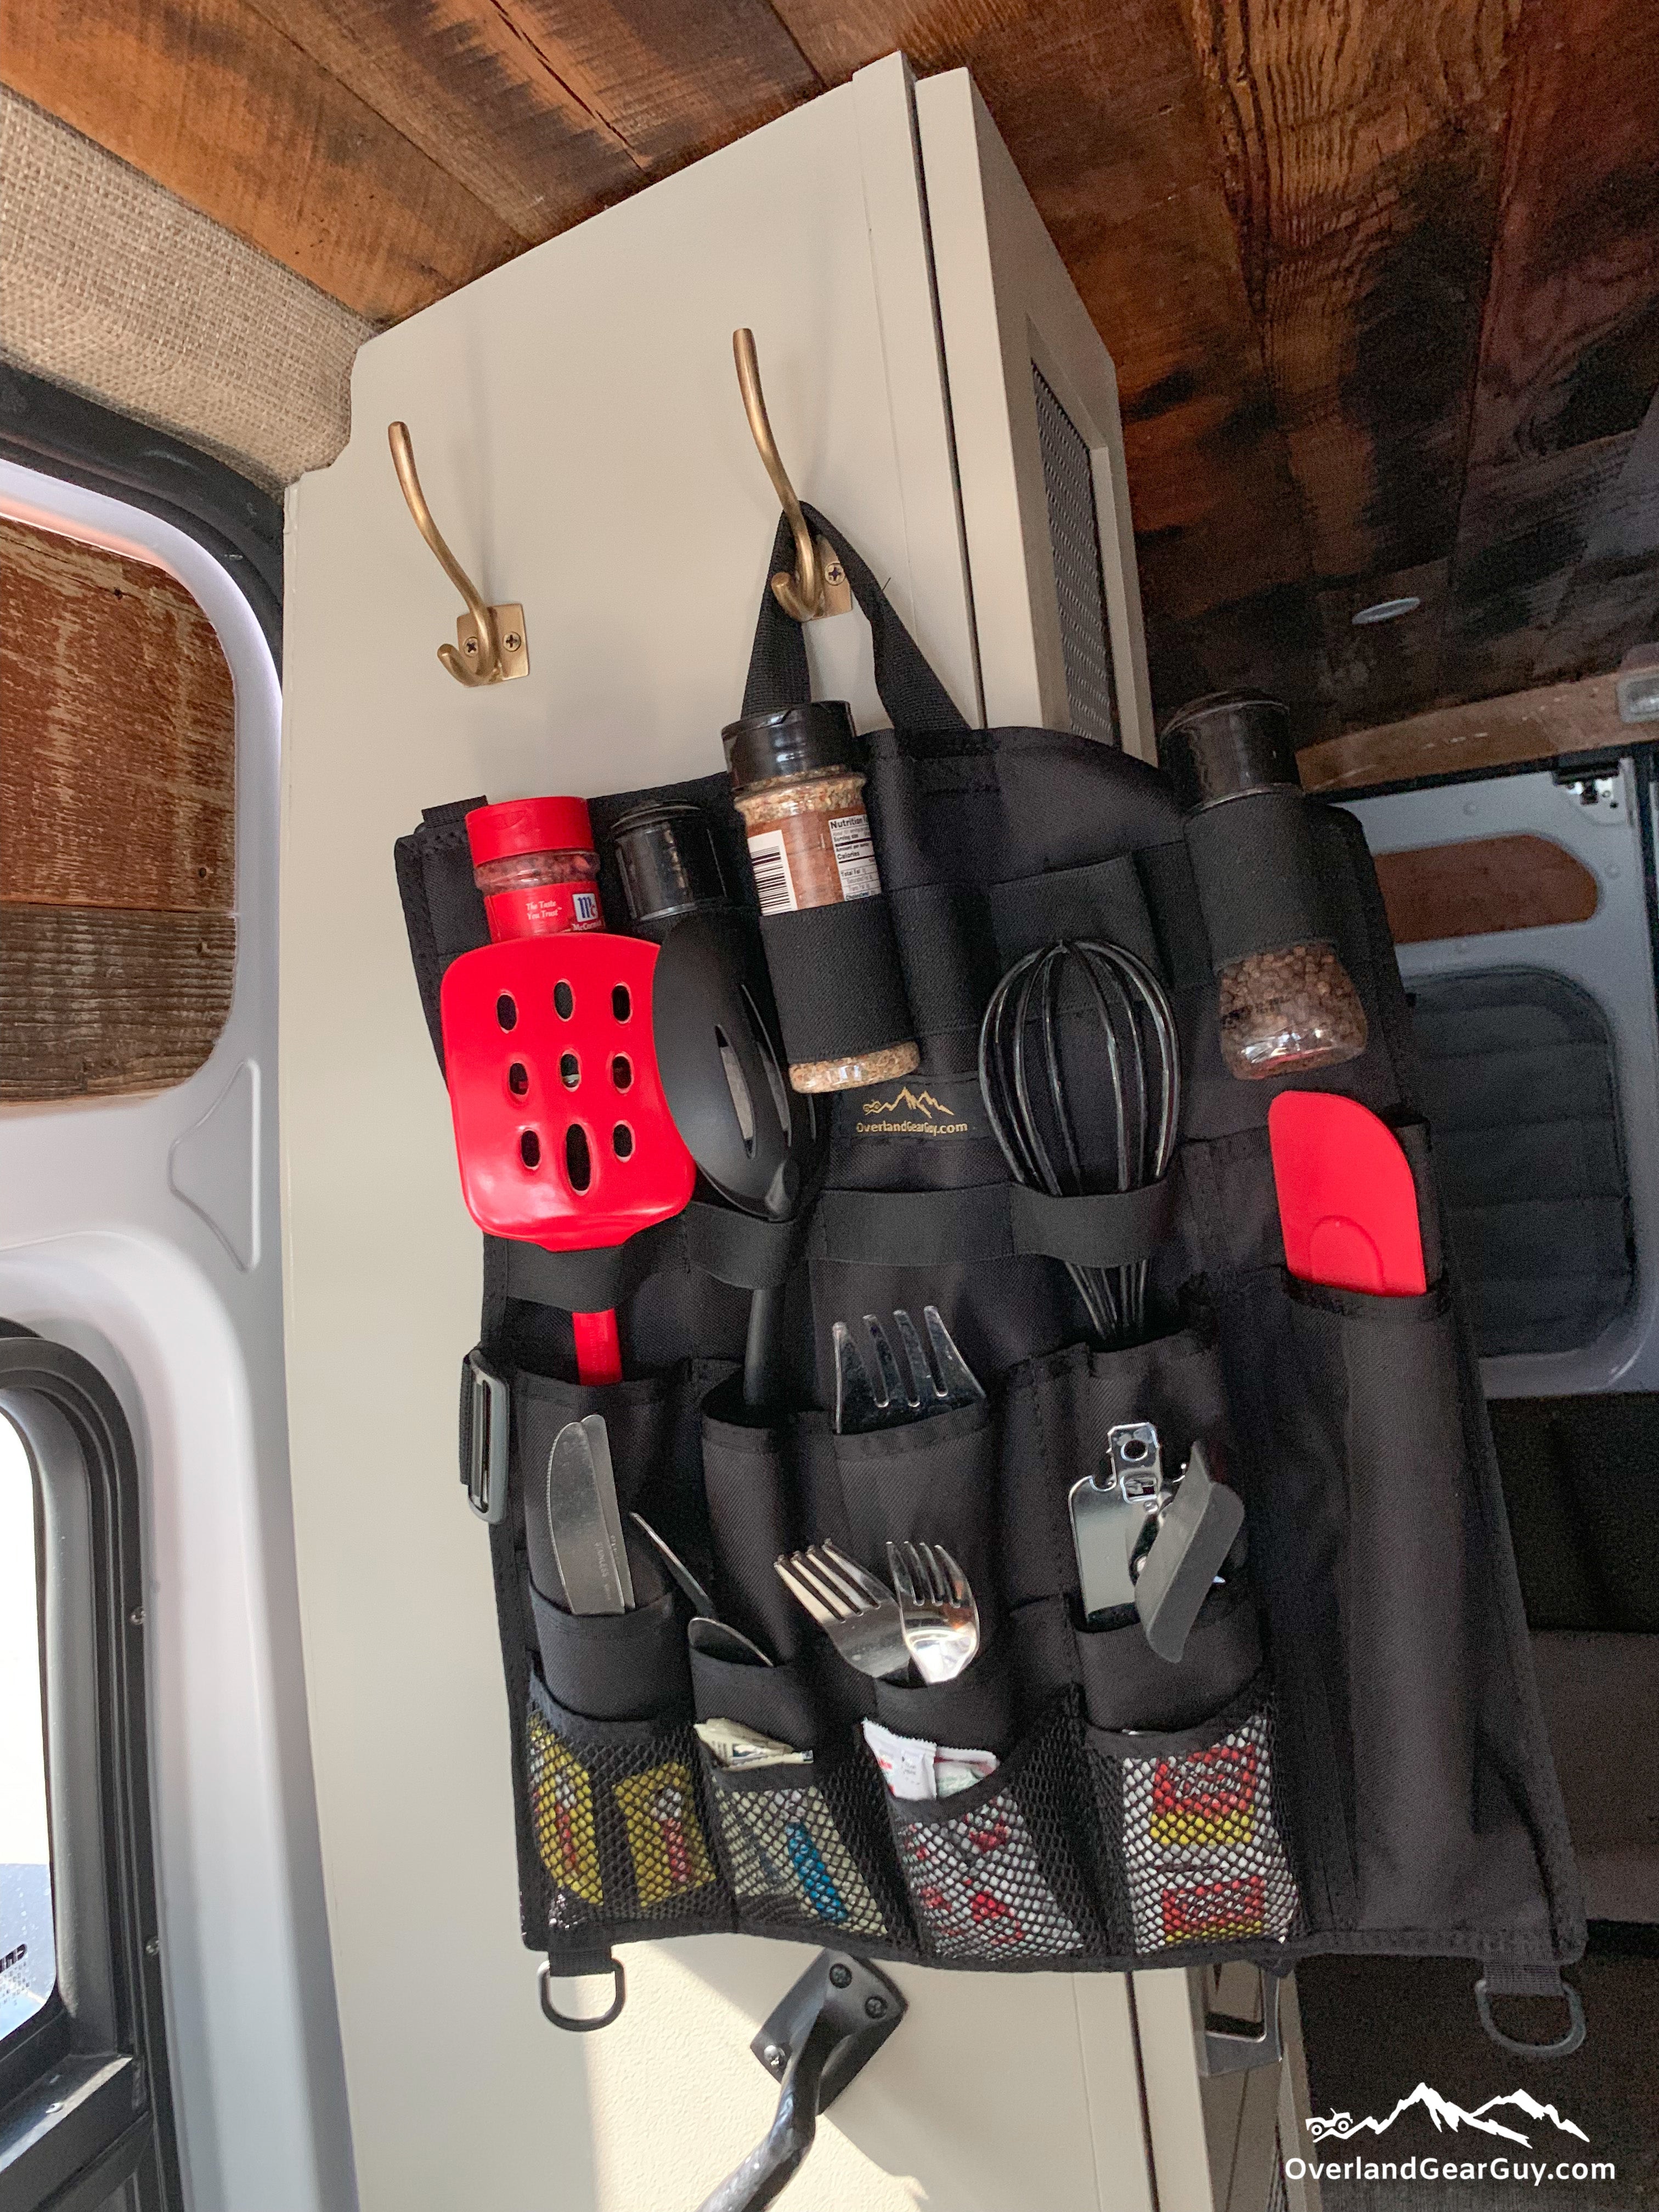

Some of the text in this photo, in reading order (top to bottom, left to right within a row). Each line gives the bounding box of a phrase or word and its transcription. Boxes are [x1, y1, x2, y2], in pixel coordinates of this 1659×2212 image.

[830, 817, 862, 829] Nutrition
[837, 851, 860, 860] Calories
[526, 901, 538, 910] The
[527, 912, 540, 920] You
[856, 1120, 968, 1136] OverlandGearGuy.com
